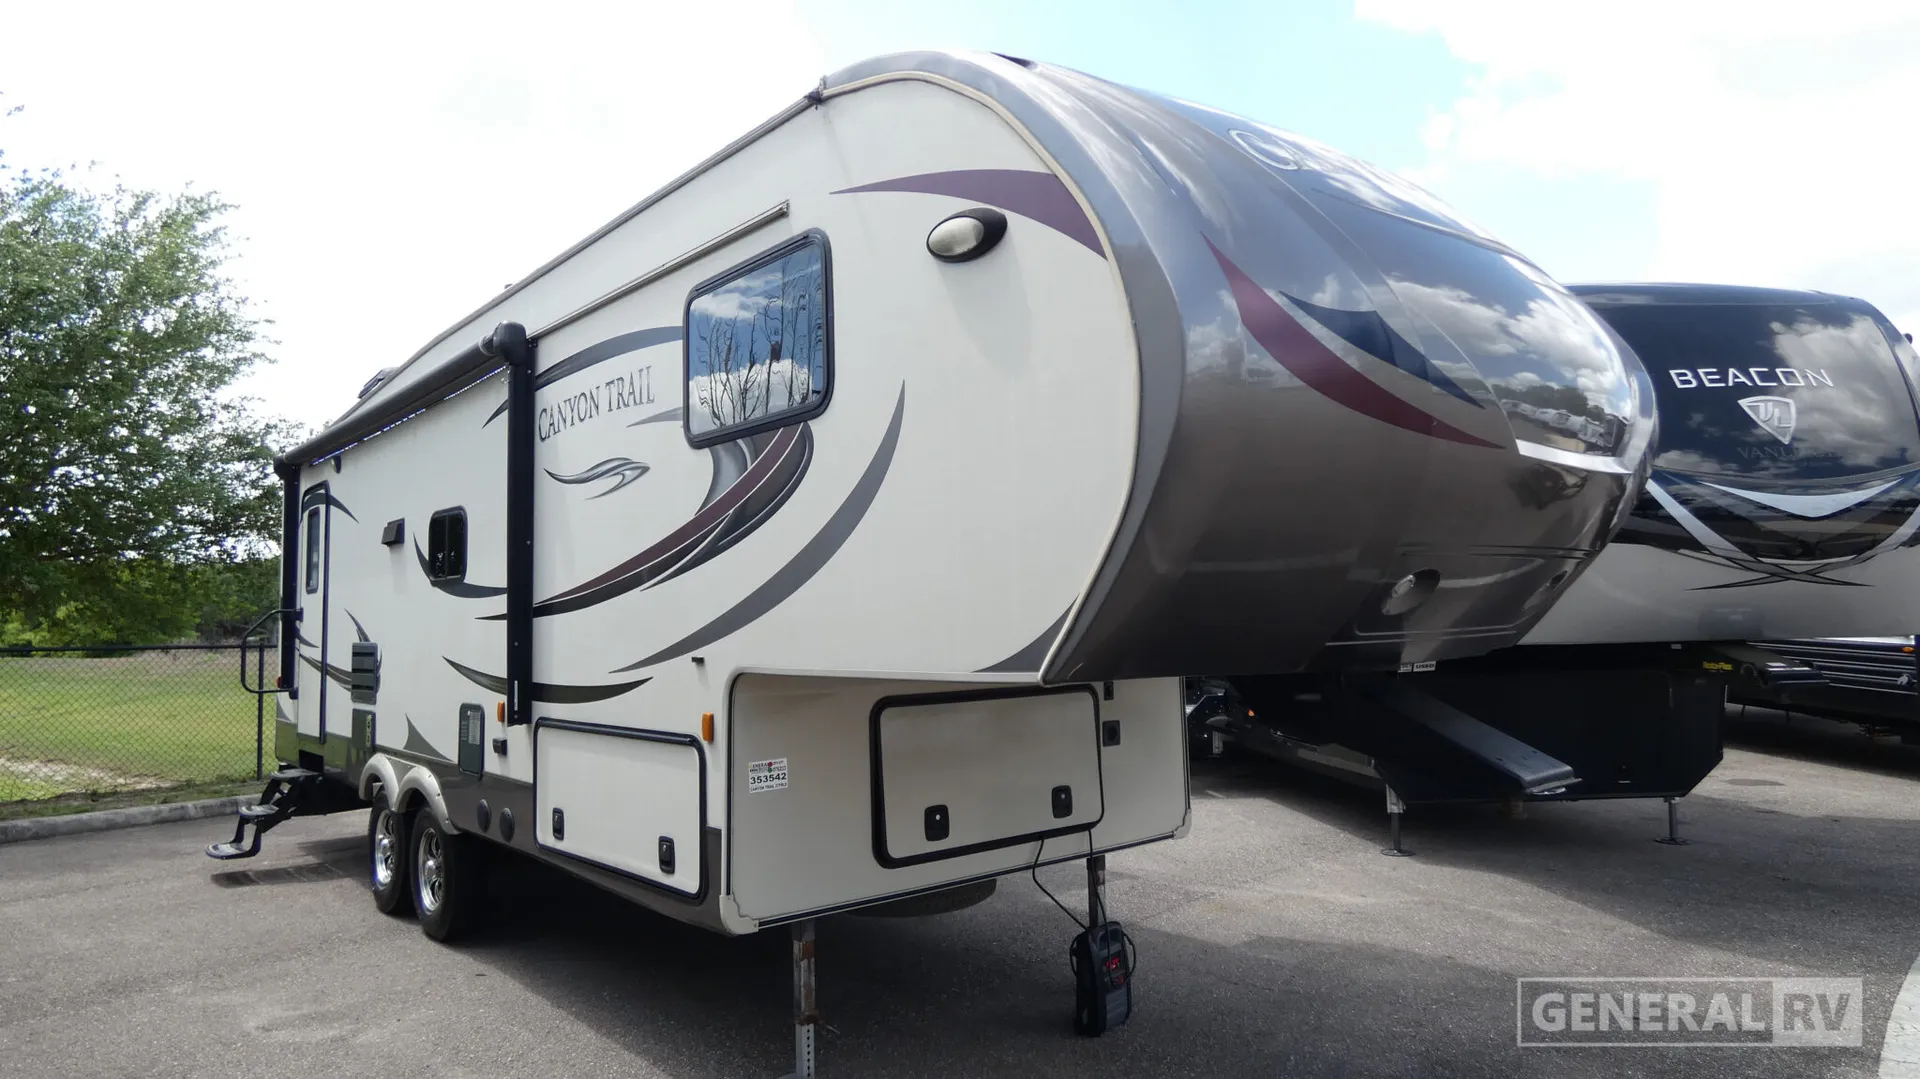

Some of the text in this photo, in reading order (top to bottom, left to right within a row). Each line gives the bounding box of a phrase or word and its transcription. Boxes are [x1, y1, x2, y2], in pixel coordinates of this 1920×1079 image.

[1669, 368, 1834, 388] BEACON
[538, 365, 655, 442] CANYON TRAIL
[750, 772, 787, 785] 353542
